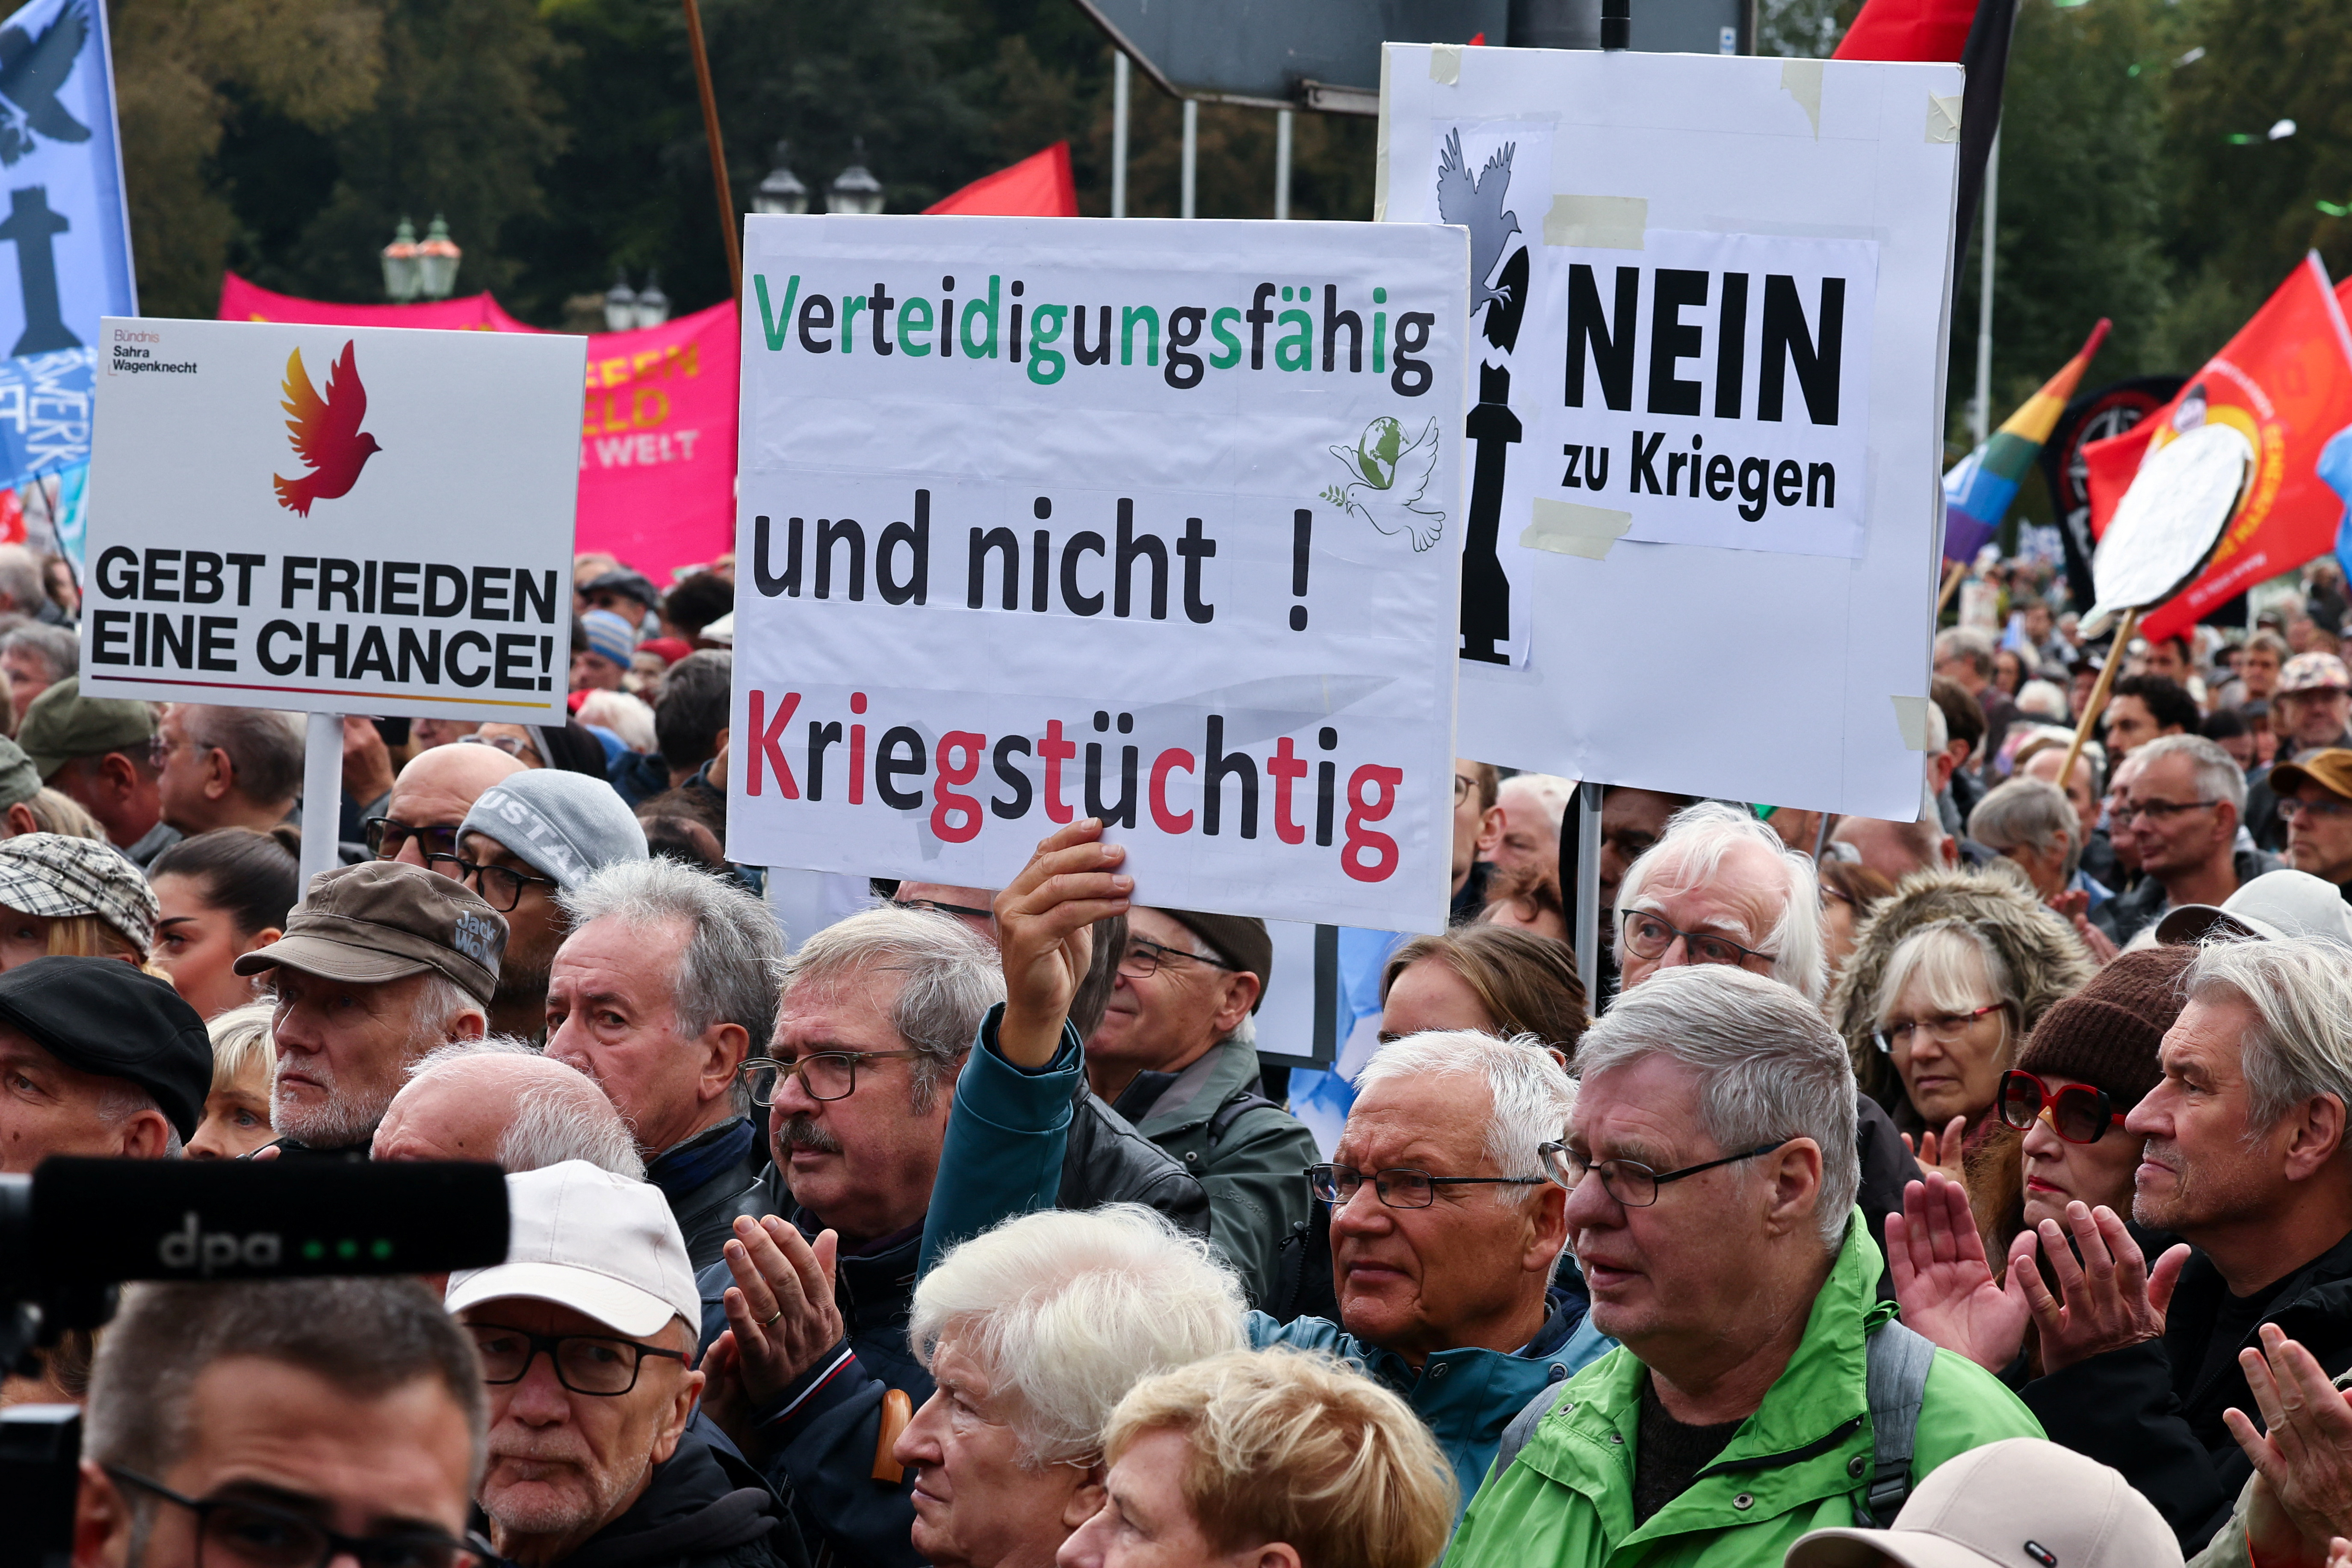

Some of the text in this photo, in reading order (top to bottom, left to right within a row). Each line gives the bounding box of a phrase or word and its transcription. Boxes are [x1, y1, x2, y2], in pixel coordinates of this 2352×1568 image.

[113, 345, 150, 358] Sahra
[113, 359, 197, 374] Wagenknecht
[114, 329, 160, 343] Bündnis
[753, 274, 1435, 397] Verteidigungsfähig
[1565, 264, 1846, 426] NEIN
[595, 429, 698, 469] WELT
[1561, 431, 1835, 522] zu Kriegen
[96, 546, 557, 624] GEBT FRIEDEN
[753, 489, 1312, 632] und nicht !
[92, 610, 553, 691] EINE CHANCE!
[746, 690, 1403, 883] Kriegstüchtig
[456, 910, 496, 941] Jack
[158, 1212, 282, 1273] dpa
